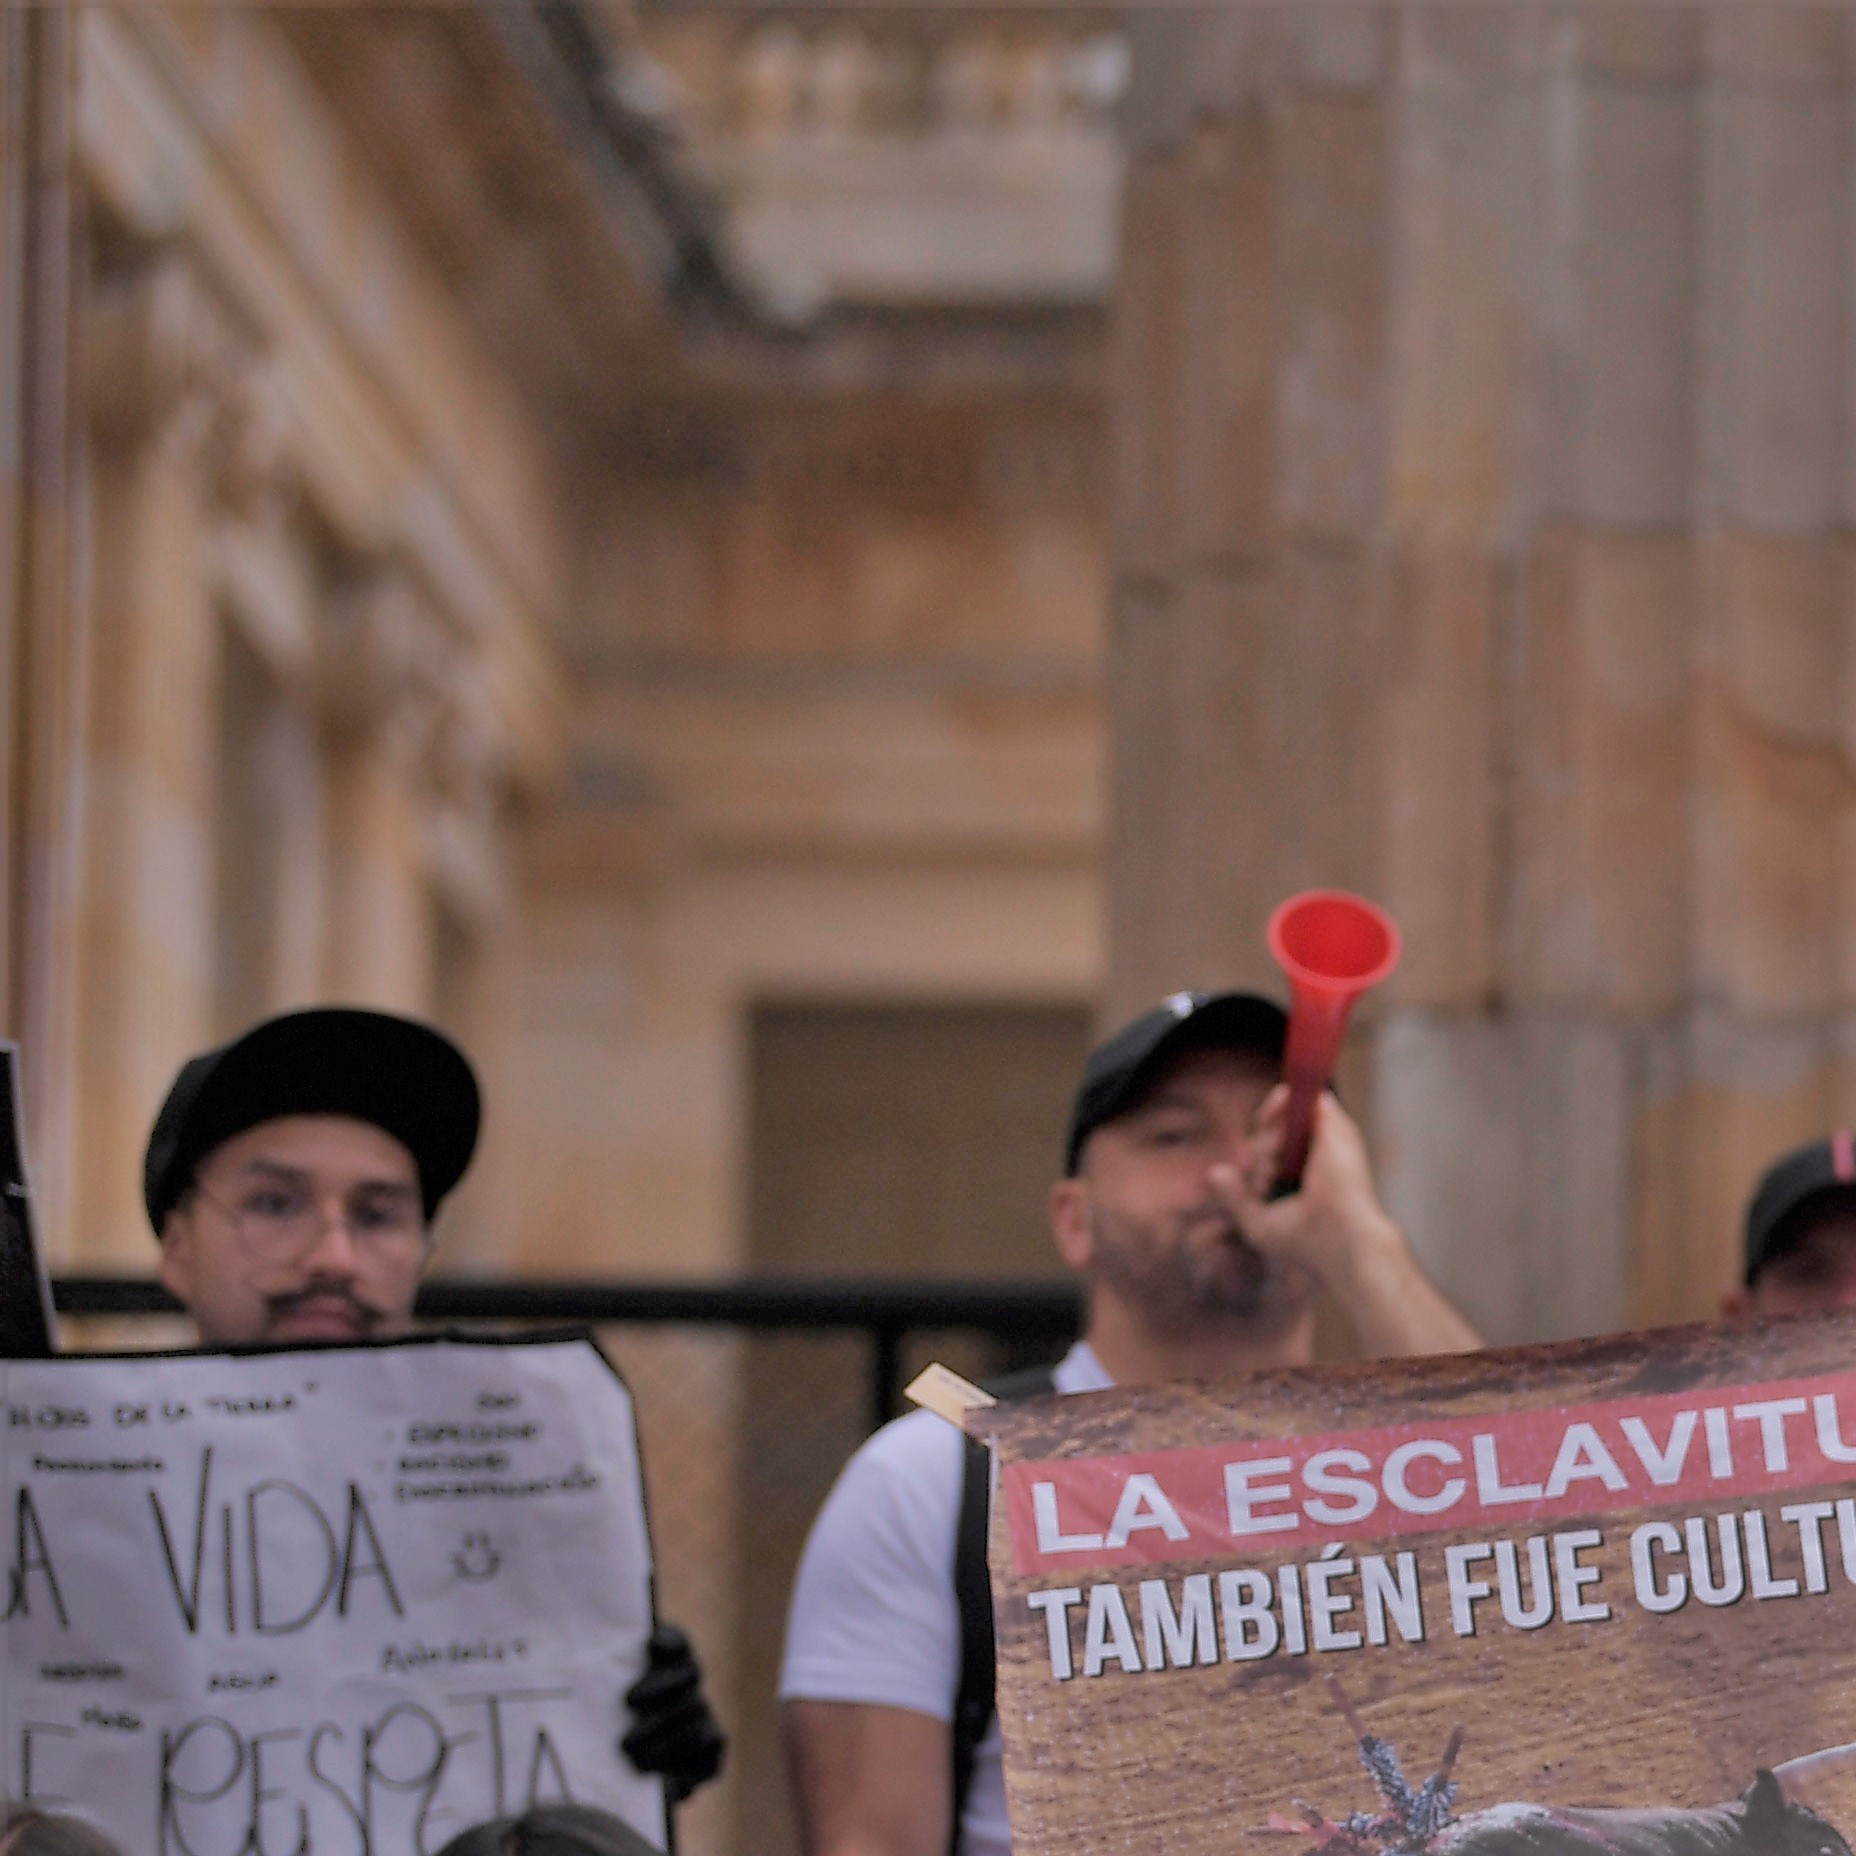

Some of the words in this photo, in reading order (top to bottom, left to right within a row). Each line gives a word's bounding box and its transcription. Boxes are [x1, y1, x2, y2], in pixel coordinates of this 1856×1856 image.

[150, 1445, 405, 1635] VIDA
[1030, 1473, 1190, 1556] LA
[1028, 1543, 1422, 1682] TAMBIÉN
[1445, 1530, 1611, 1636] FUE
